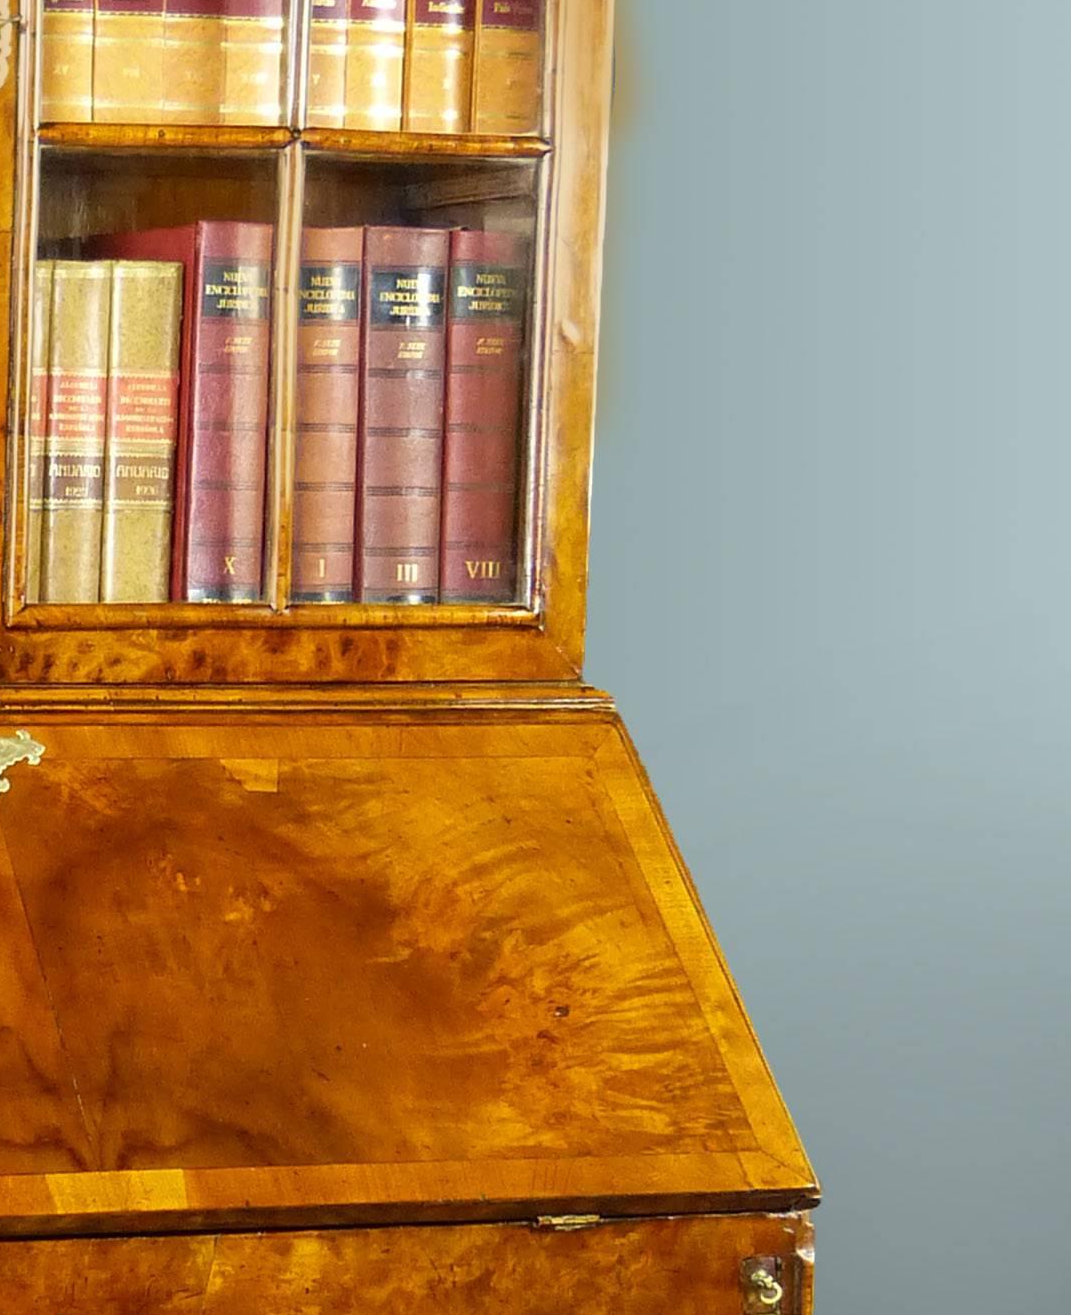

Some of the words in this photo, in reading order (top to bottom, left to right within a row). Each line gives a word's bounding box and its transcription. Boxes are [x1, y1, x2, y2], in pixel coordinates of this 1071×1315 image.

[299, 290, 355, 301] NCICLOPEDIA
[49, 465, 100, 478] ANUARIO
[117, 465, 169, 480] ANUARIO
[223, 557, 236, 574] X
[318, 559, 325, 577] I
[396, 564, 419, 582] III
[465, 561, 502, 579] VIII
